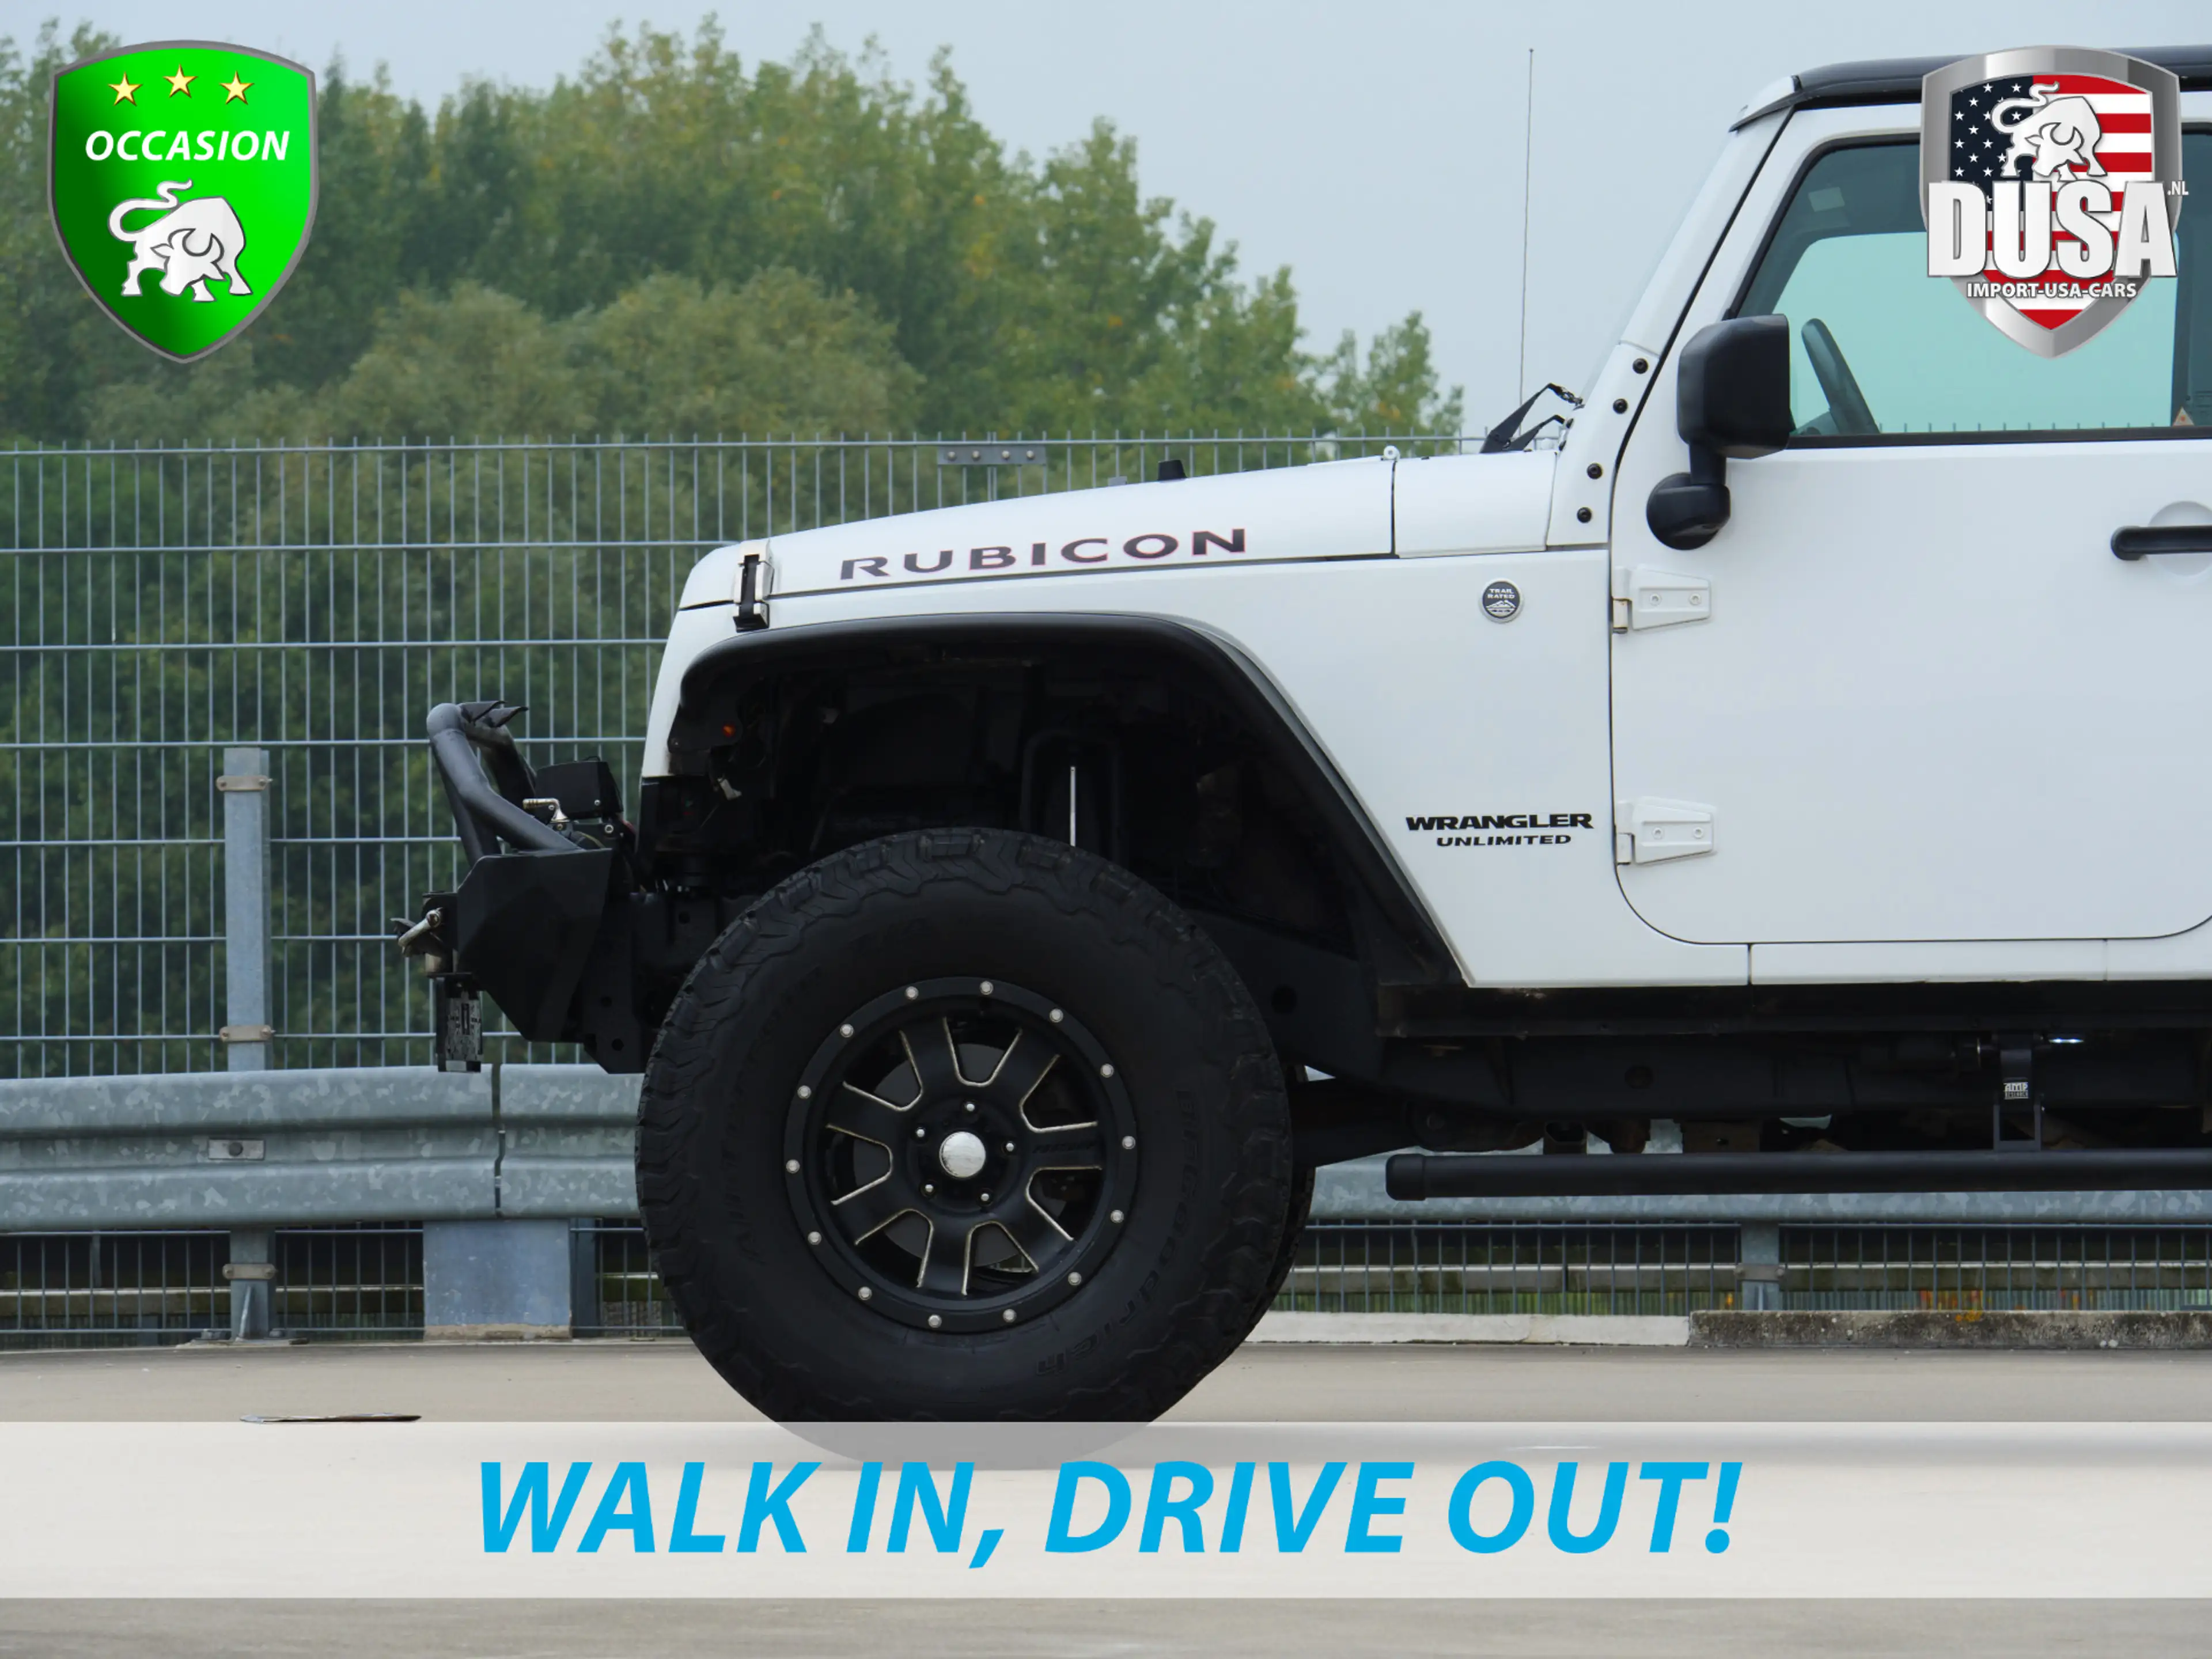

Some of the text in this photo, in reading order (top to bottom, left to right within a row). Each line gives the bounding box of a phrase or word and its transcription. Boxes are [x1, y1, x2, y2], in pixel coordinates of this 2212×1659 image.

[840, 528, 1247, 580] RUBICON
[1406, 813, 1594, 830] WRANGLER
[1436, 835, 1571, 847] UNLIMITED
